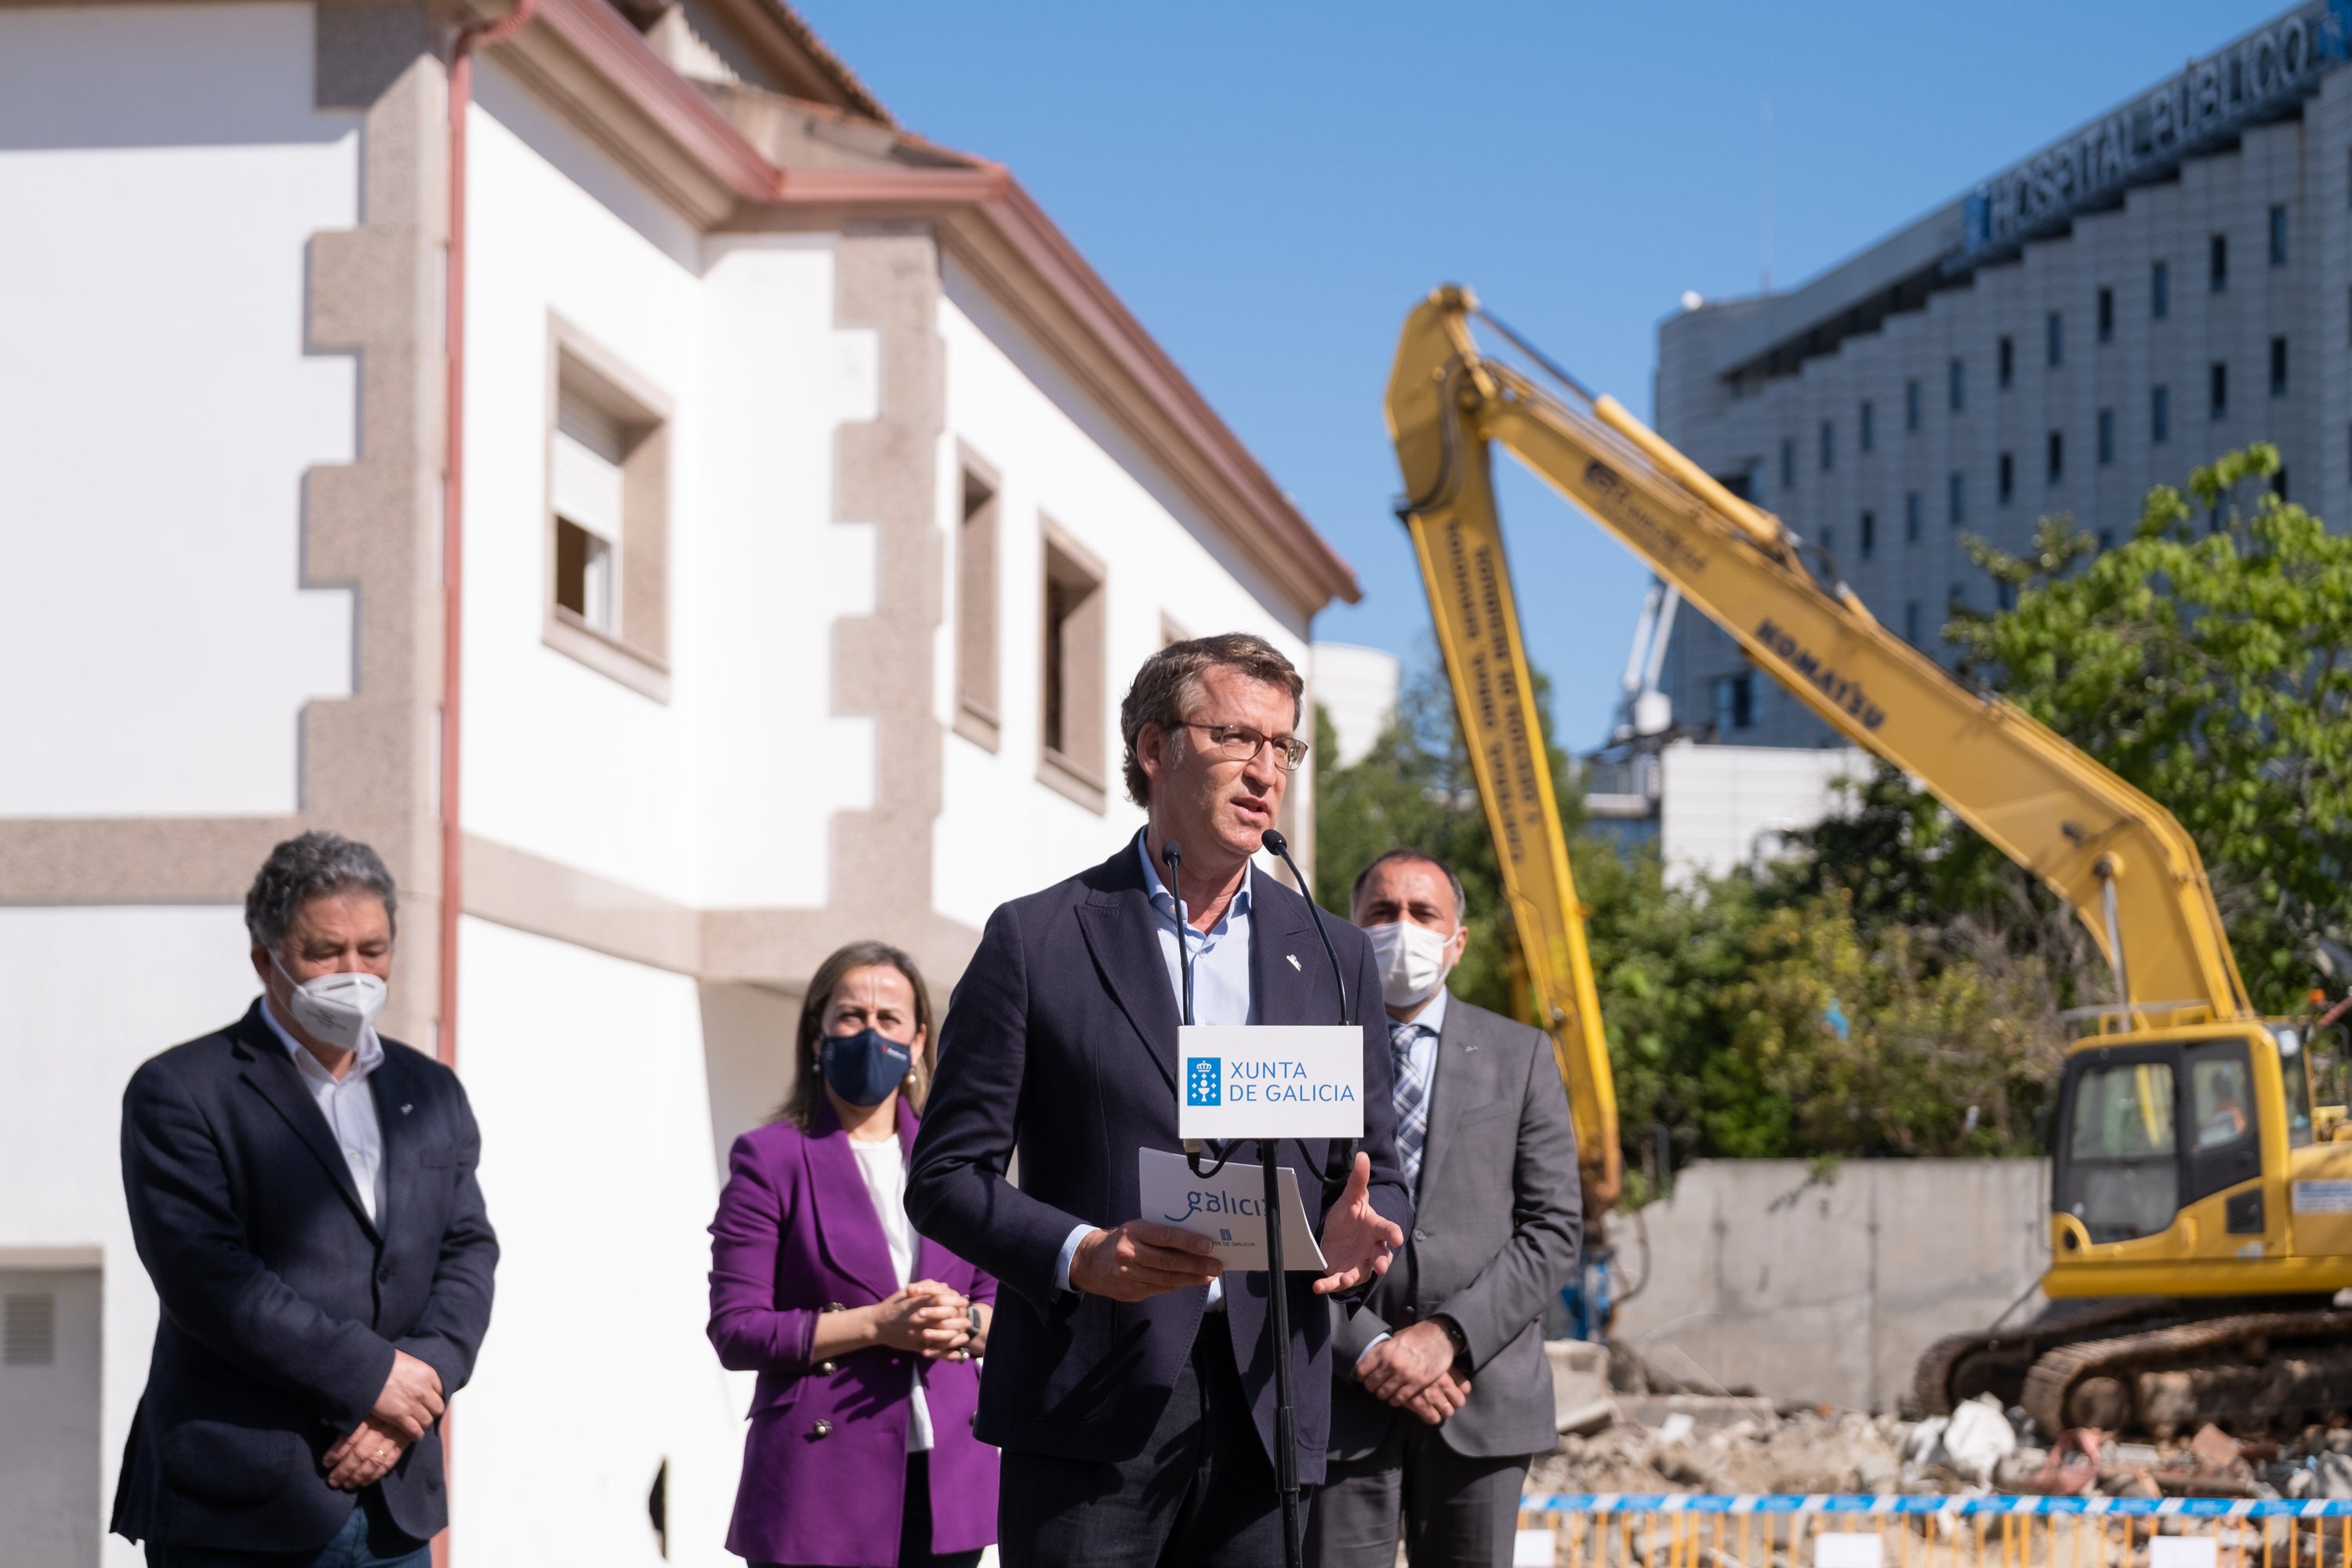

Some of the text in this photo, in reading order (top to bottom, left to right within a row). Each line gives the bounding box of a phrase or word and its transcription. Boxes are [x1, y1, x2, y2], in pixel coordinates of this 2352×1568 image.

[1990, 109, 2144, 240] HOSPITAL
[1755, 618, 1886, 730] KOMATSU
[1230, 1062, 1308, 1080] XUNTA
[1229, 1083, 1356, 1102] DE GALICIA
[1163, 1190, 1267, 1222] galici
